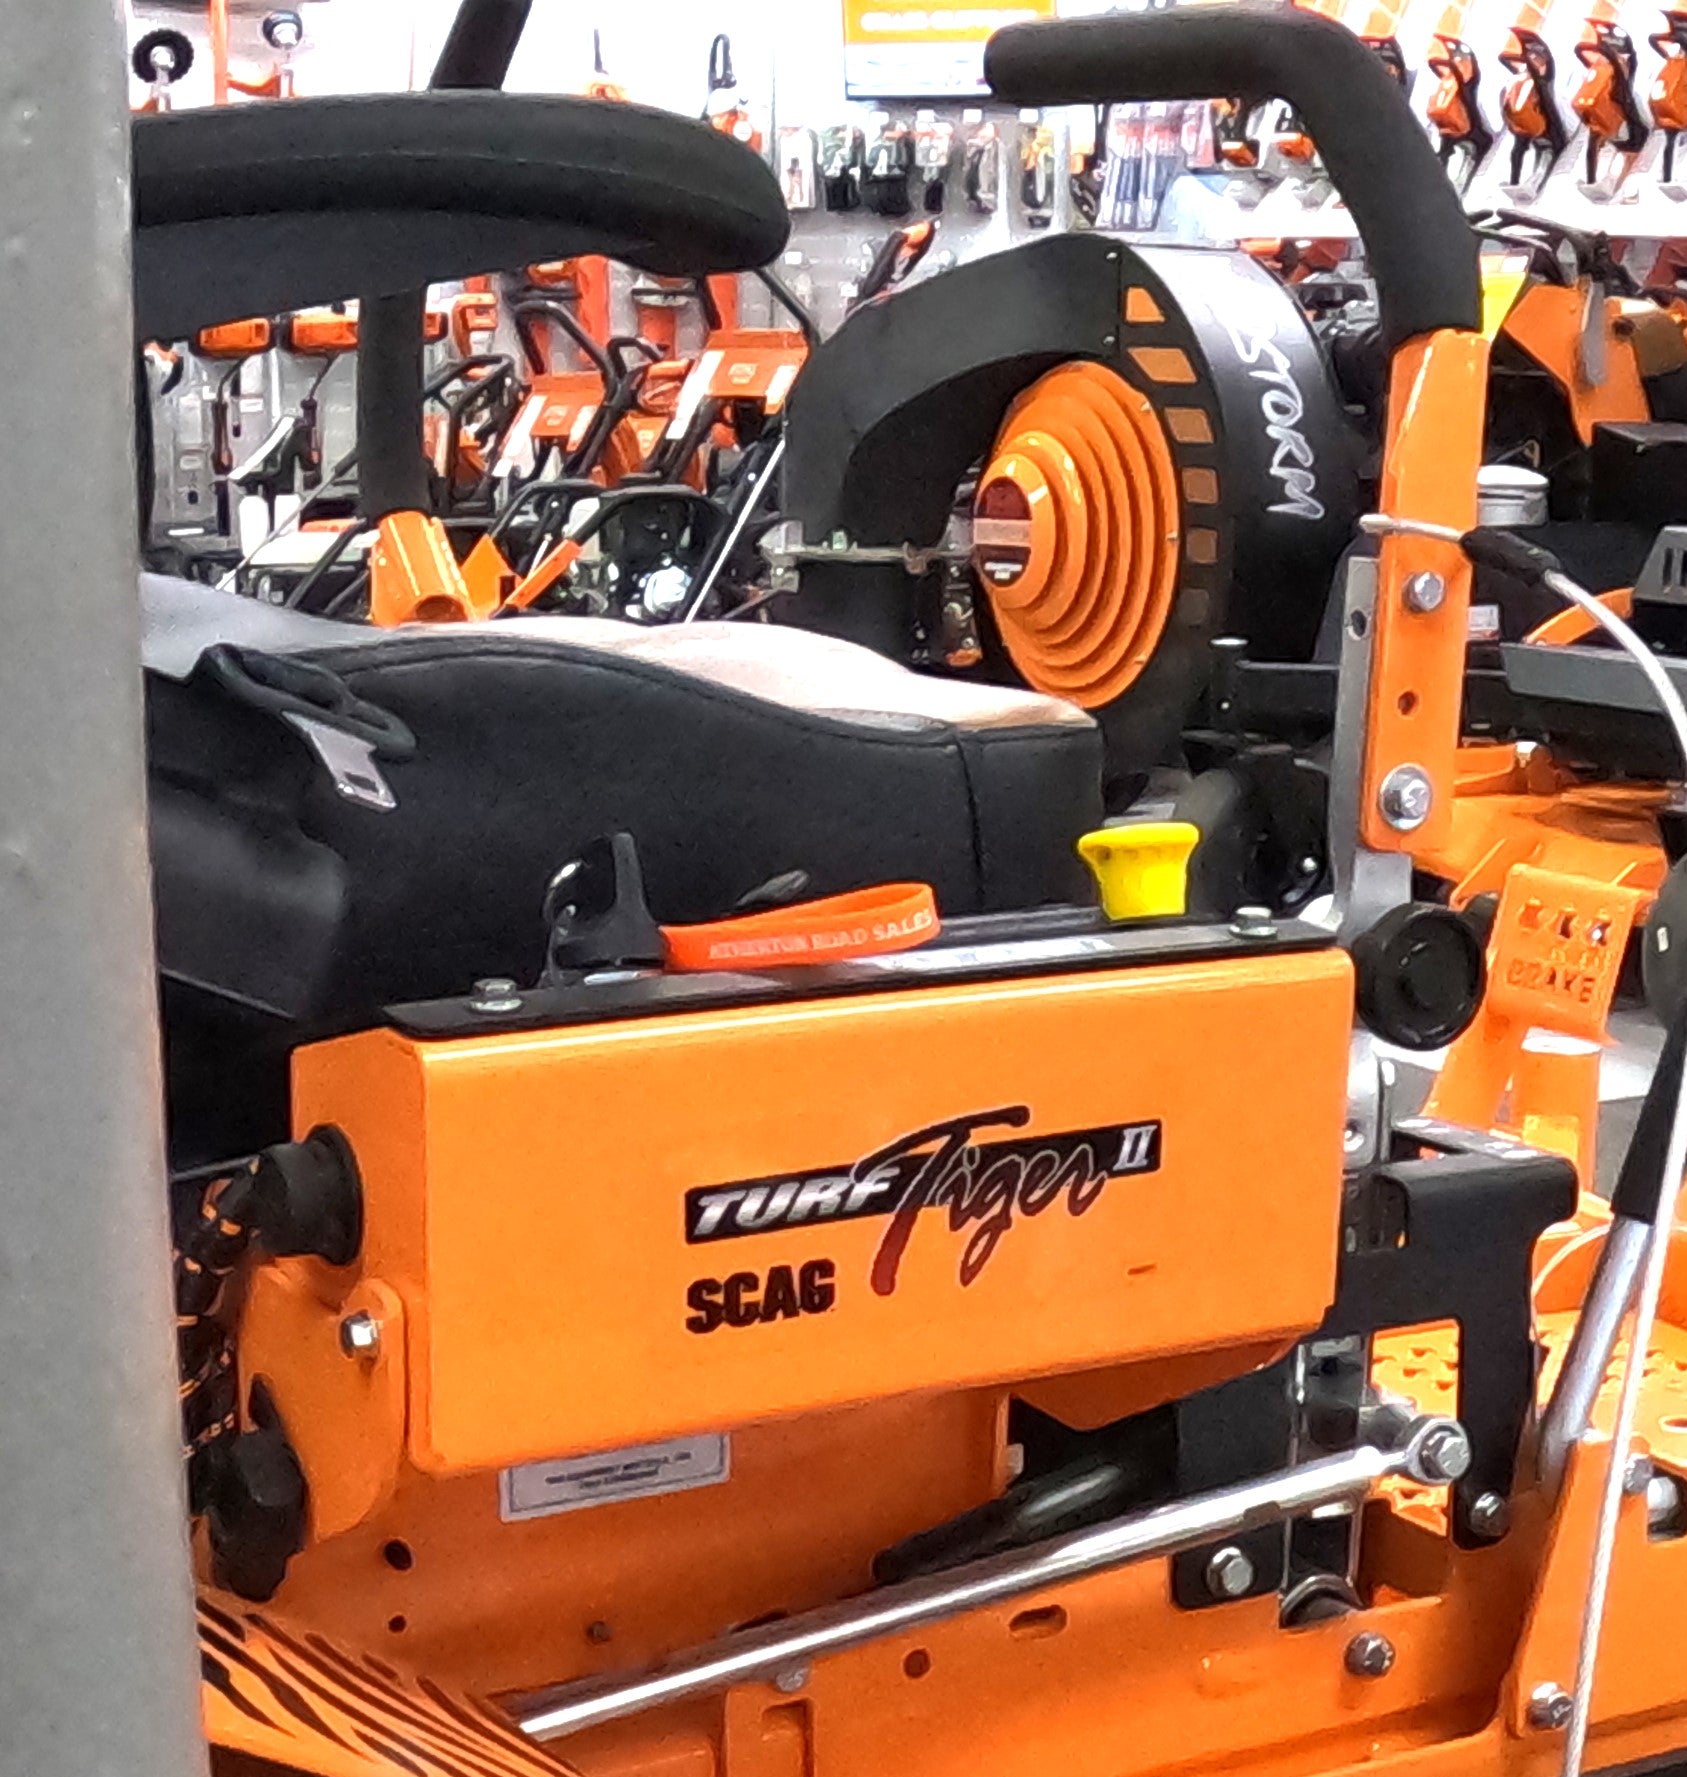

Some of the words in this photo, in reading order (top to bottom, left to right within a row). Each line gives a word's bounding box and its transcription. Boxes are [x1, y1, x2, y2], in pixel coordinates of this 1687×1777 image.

[811, 927, 869, 951] ROAD
[872, 907, 932, 942] SALES
[692, 1167, 901, 1237] TURF
[852, 1105, 1108, 1297] Tiger
[1112, 1124, 1157, 1171] II
[685, 1258, 836, 1335] SCAG
